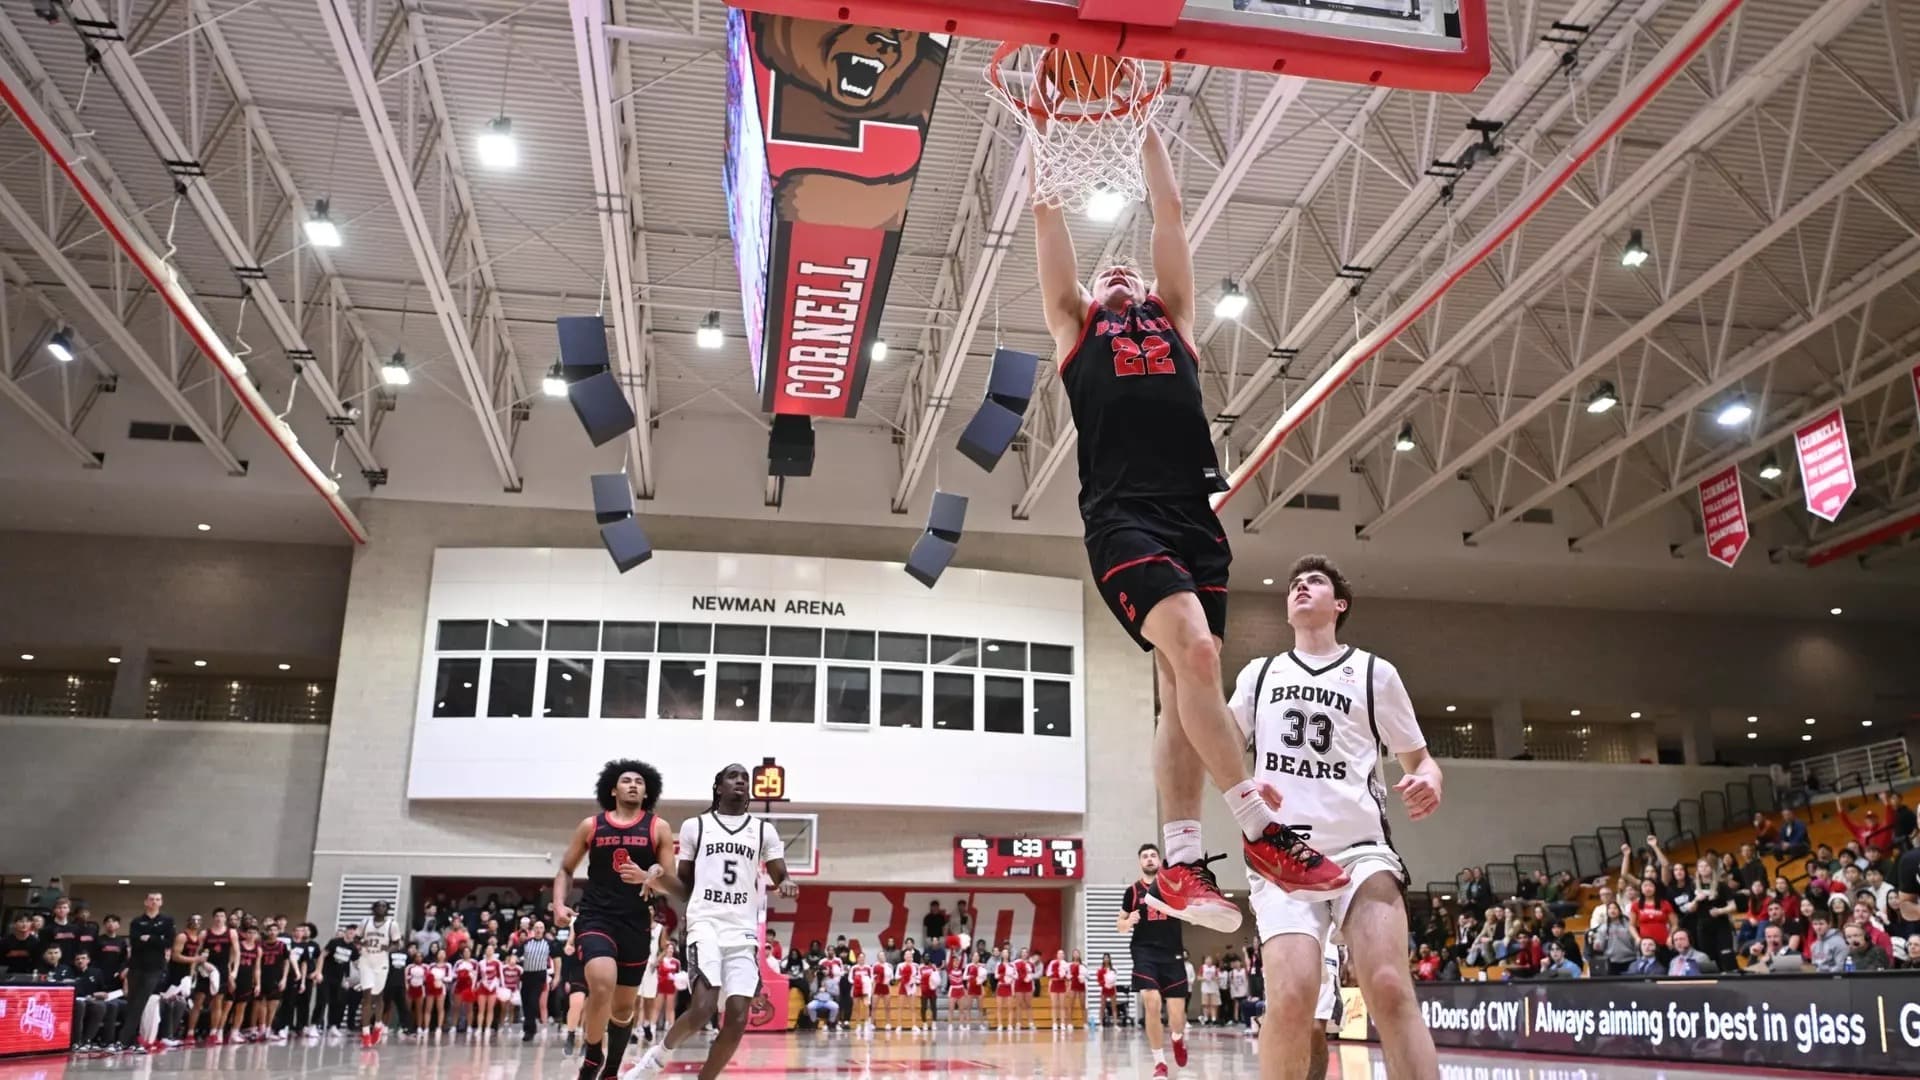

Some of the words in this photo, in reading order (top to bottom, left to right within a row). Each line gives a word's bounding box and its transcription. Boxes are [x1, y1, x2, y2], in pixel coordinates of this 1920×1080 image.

[784, 257, 869, 400] CORNELL
[1111, 336, 1176, 376] 22
[692, 596, 776, 613] NEWMAN
[784, 600, 846, 616] ARENA
[1270, 685, 1353, 715] BROWN
[1281, 707, 1334, 754] 33
[1265, 752, 1347, 780] BEARS
[755, 775, 782, 797] 29
[596, 836, 620, 846] BIG
[622, 836, 648, 846] RED
[706, 842, 755, 860] BROWN
[1054, 850, 1077, 868] 40
[722, 860, 738, 885] 5
[704, 889, 748, 905] BEARS
[1431, 1001, 1468, 1030] Doors
[1470, 1001, 1486, 1030] of
[1487, 1001, 1519, 1031] CNY
[1534, 1002, 1595, 1042] Always
[1598, 1001, 1664, 1045] aiming
[1667, 1002, 1699, 1038] for
[1703, 1002, 1758, 1041] best
[1762, 1002, 1788, 1042] in
[1794, 1003, 1866, 1053] glass
